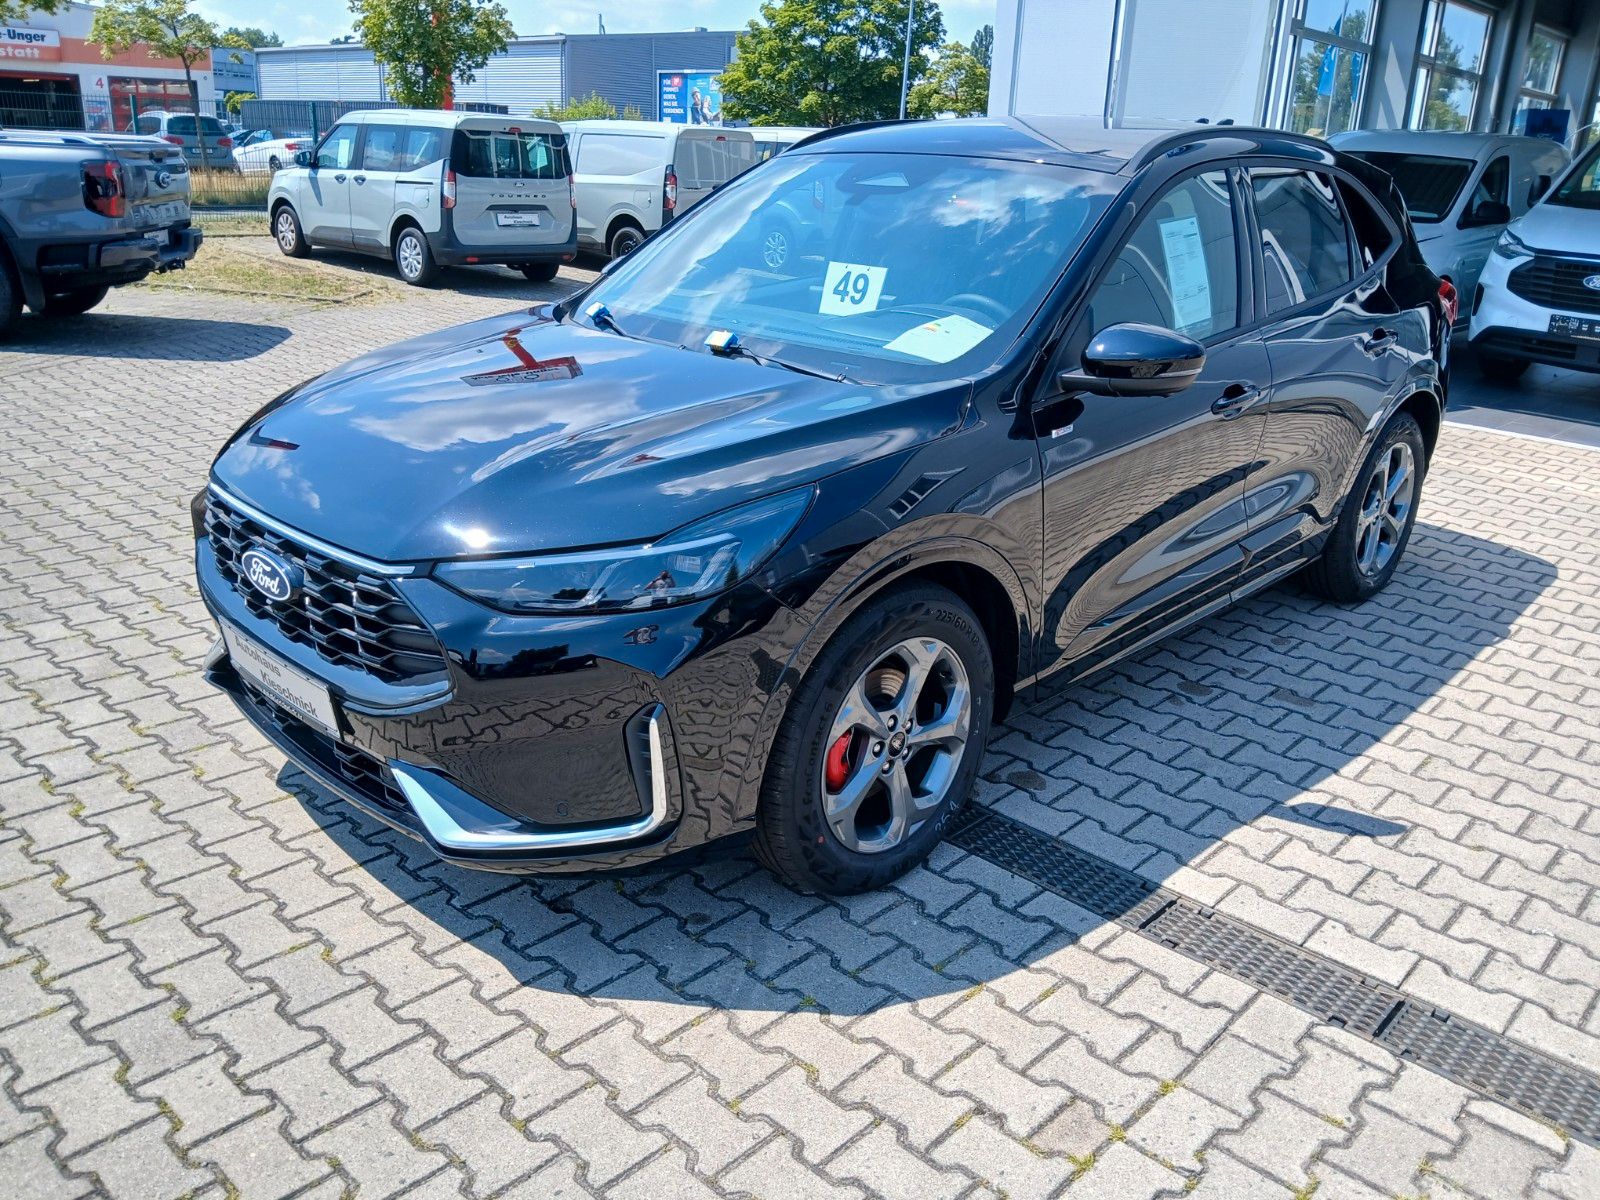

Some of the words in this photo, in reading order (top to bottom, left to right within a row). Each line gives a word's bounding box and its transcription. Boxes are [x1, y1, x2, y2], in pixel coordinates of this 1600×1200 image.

[95, 77, 104, 89] 4
[832, 270, 870, 305] 49
[249, 557, 280, 595] Ford
[234, 635, 282, 677] Autohaus
[260, 668, 318, 718] Kieschnick
